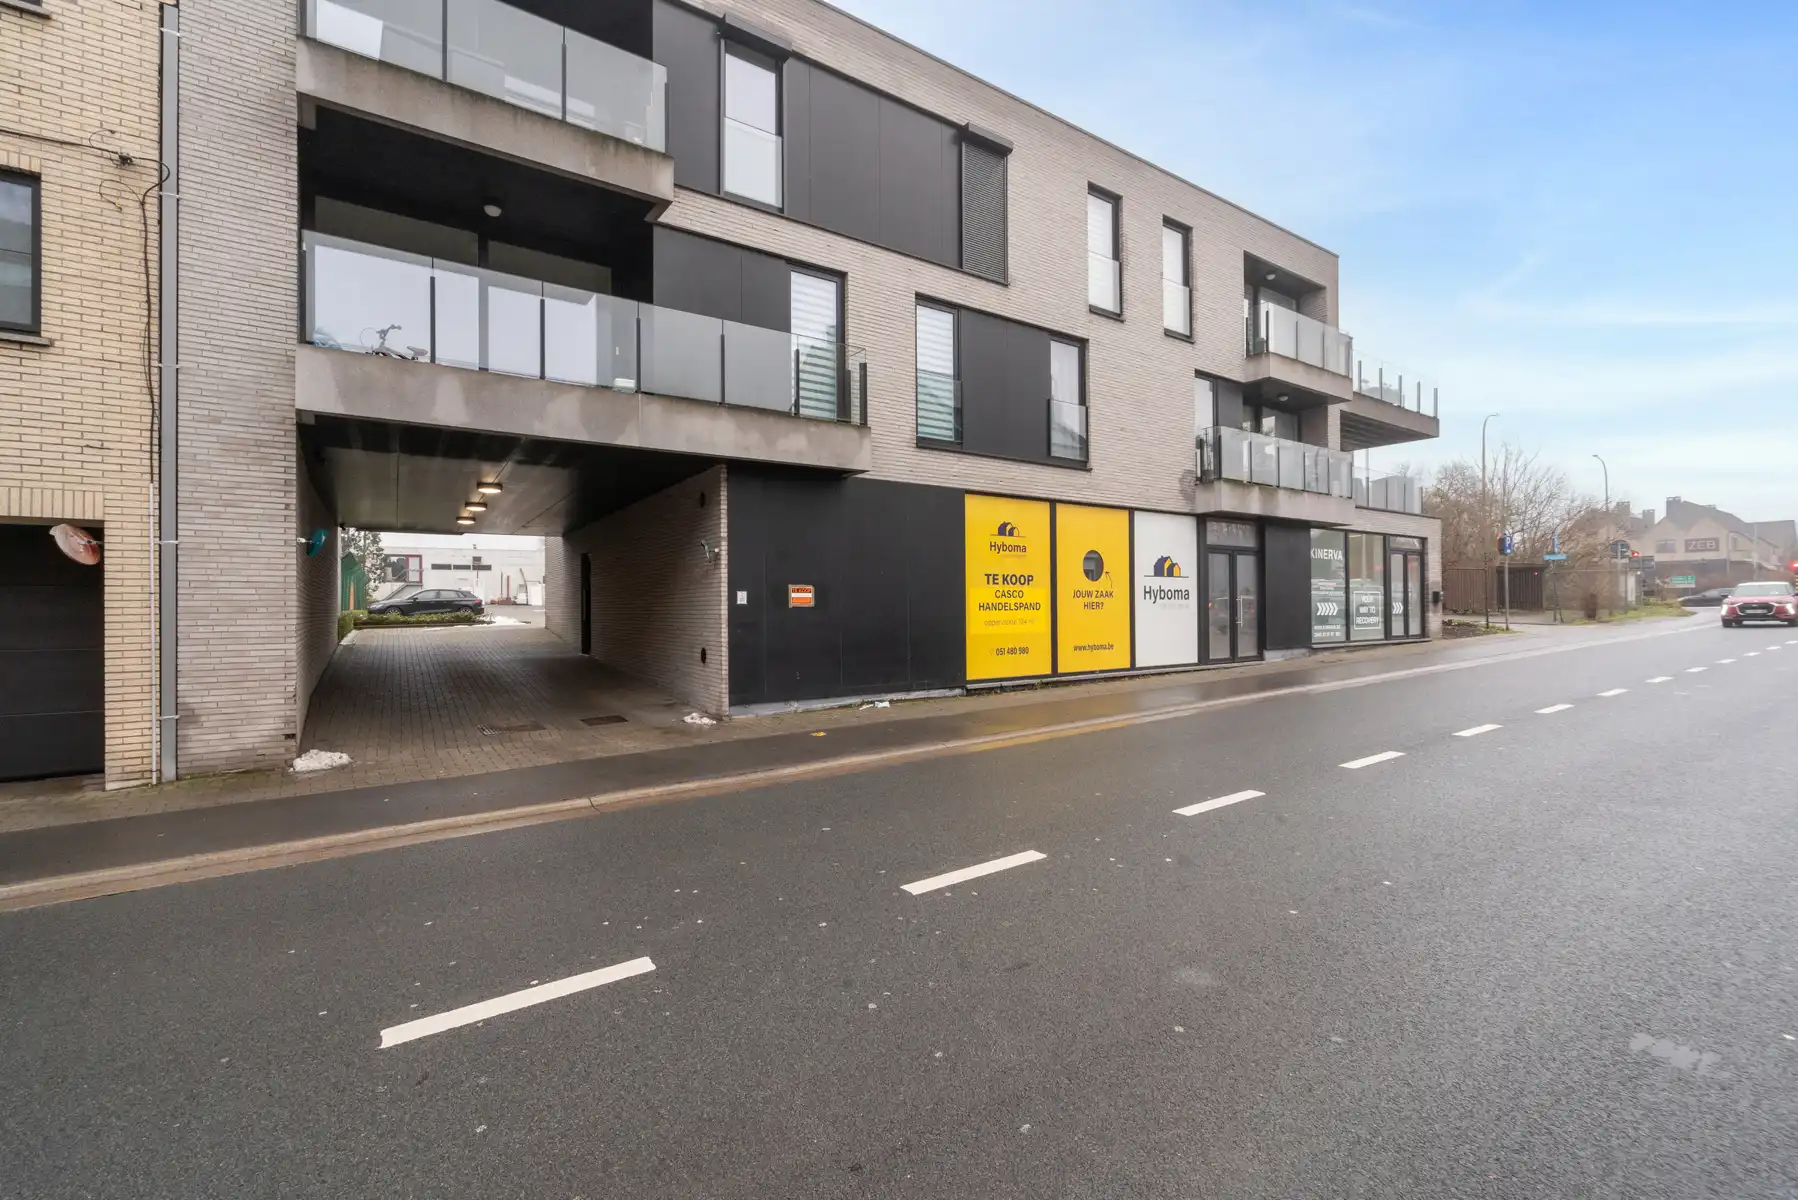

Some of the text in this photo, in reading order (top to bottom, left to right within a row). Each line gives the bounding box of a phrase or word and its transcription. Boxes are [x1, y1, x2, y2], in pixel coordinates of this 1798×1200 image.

[989, 541, 1027, 554] Hyboma
[1688, 540, 1715, 550] ZEB
[1311, 548, 1343, 560] KINERVA
[984, 573, 1034, 586] TE KOOP
[994, 589, 1024, 599] CASCO
[1072, 589, 1114, 599] JOUW ZAAK
[1143, 585, 1190, 604] Hyboma
[978, 602, 1041, 611] HANDELSPAND
[1083, 601, 1104, 610] HIER?
[1356, 616, 1379, 624] RECOVERY
[996, 647, 1005, 656] 051
[1007, 646, 1017, 655] 480
[1073, 642, 1114, 652] www.hyboma.be
